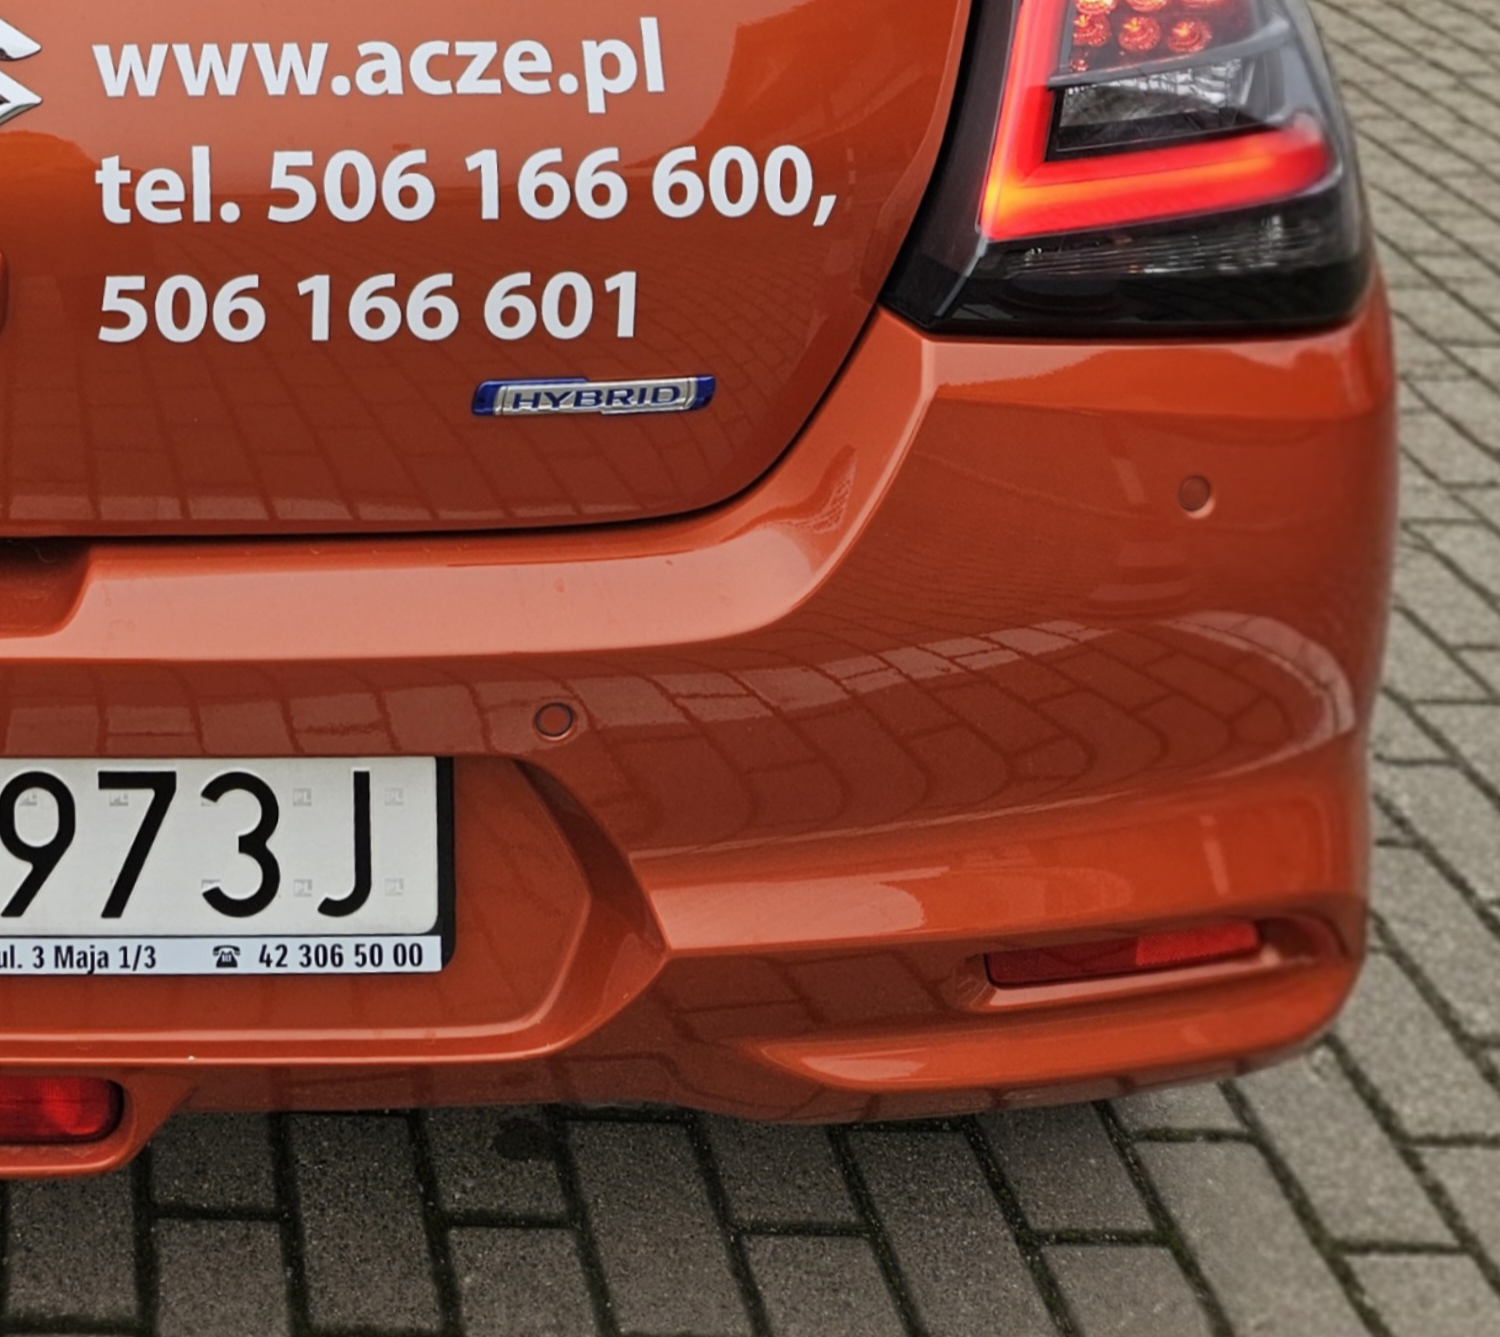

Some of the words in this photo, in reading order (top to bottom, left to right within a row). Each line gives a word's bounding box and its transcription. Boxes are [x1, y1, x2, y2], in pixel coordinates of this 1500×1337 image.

[92, 16, 666, 114] www.acze.pl
[94, 144, 241, 225] tel.
[267, 148, 436, 223] 506
[465, 146, 629, 222] 166
[651, 144, 838, 227] 600,
[98, 274, 267, 344] 506
[297, 272, 460, 343] 166
[482, 269, 638, 341] 601
[511, 385, 682, 410] HYBRID
[32, 944, 46, 970] 3
[53, 945, 110, 974] Maja
[119, 944, 158, 970] 1/3
[258, 943, 289, 969] 42
[298, 943, 345, 969] 306
[354, 943, 384, 969] 50
[392, 943, 424, 969] 00
